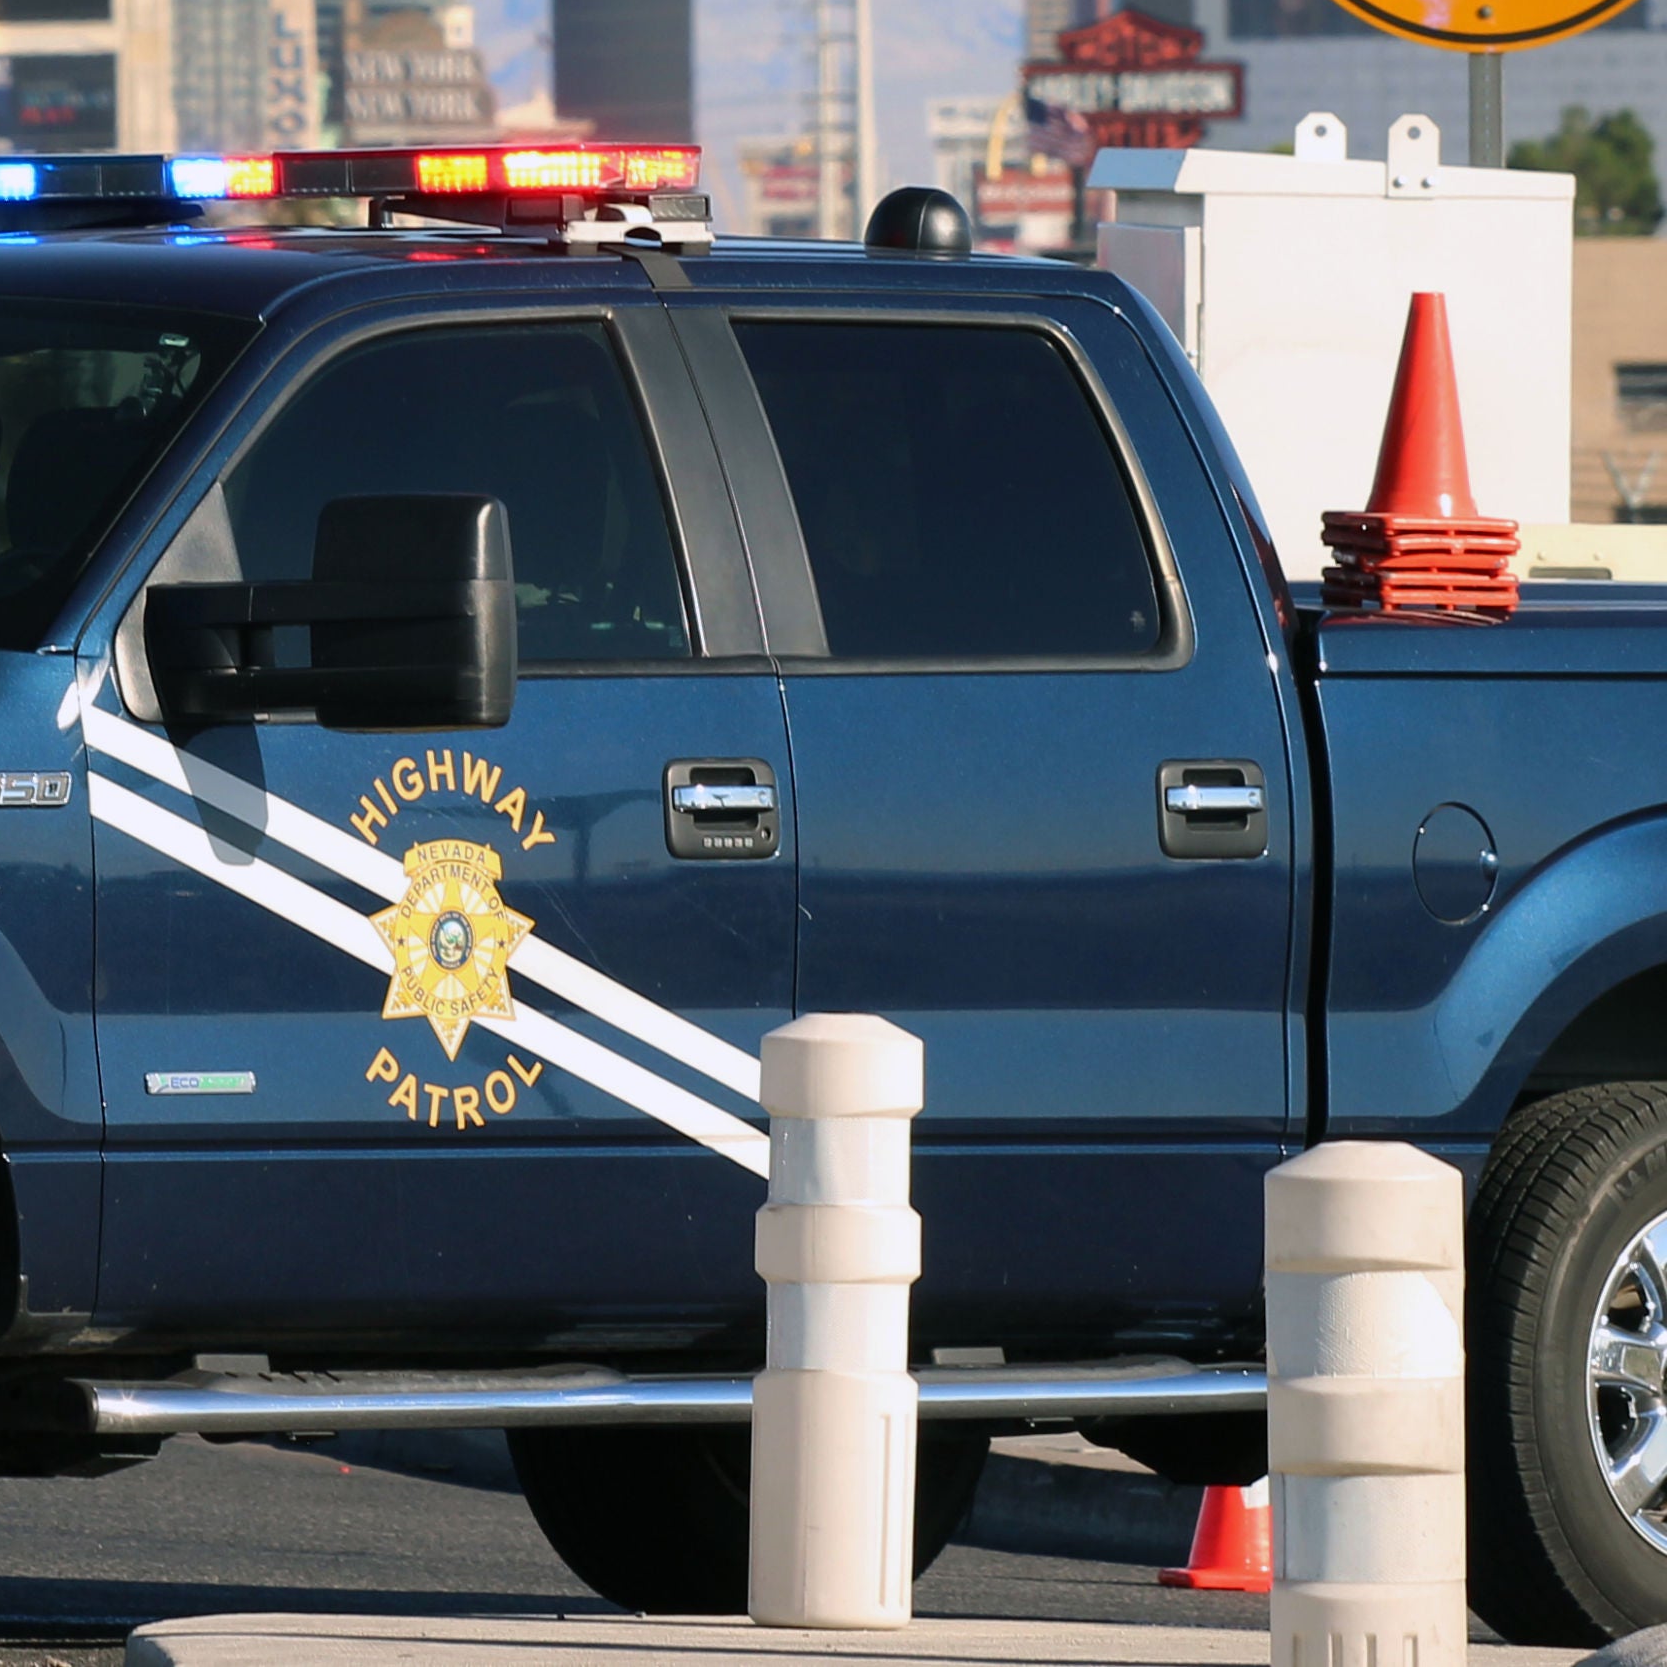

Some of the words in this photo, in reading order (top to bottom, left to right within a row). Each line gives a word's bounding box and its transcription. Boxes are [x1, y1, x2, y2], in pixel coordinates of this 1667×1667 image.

[271, 11, 308, 149] LUXO
[350, 749, 556, 851] HIGHWAY
[417, 843, 486, 864] NEVADA
[400, 863, 491, 920] DEPARTMENT
[488, 895, 506, 921] OF
[400, 964, 445, 1016] PUBLIC
[450, 966, 499, 1017] SAFETY
[364, 1045, 544, 1132] PATROL
